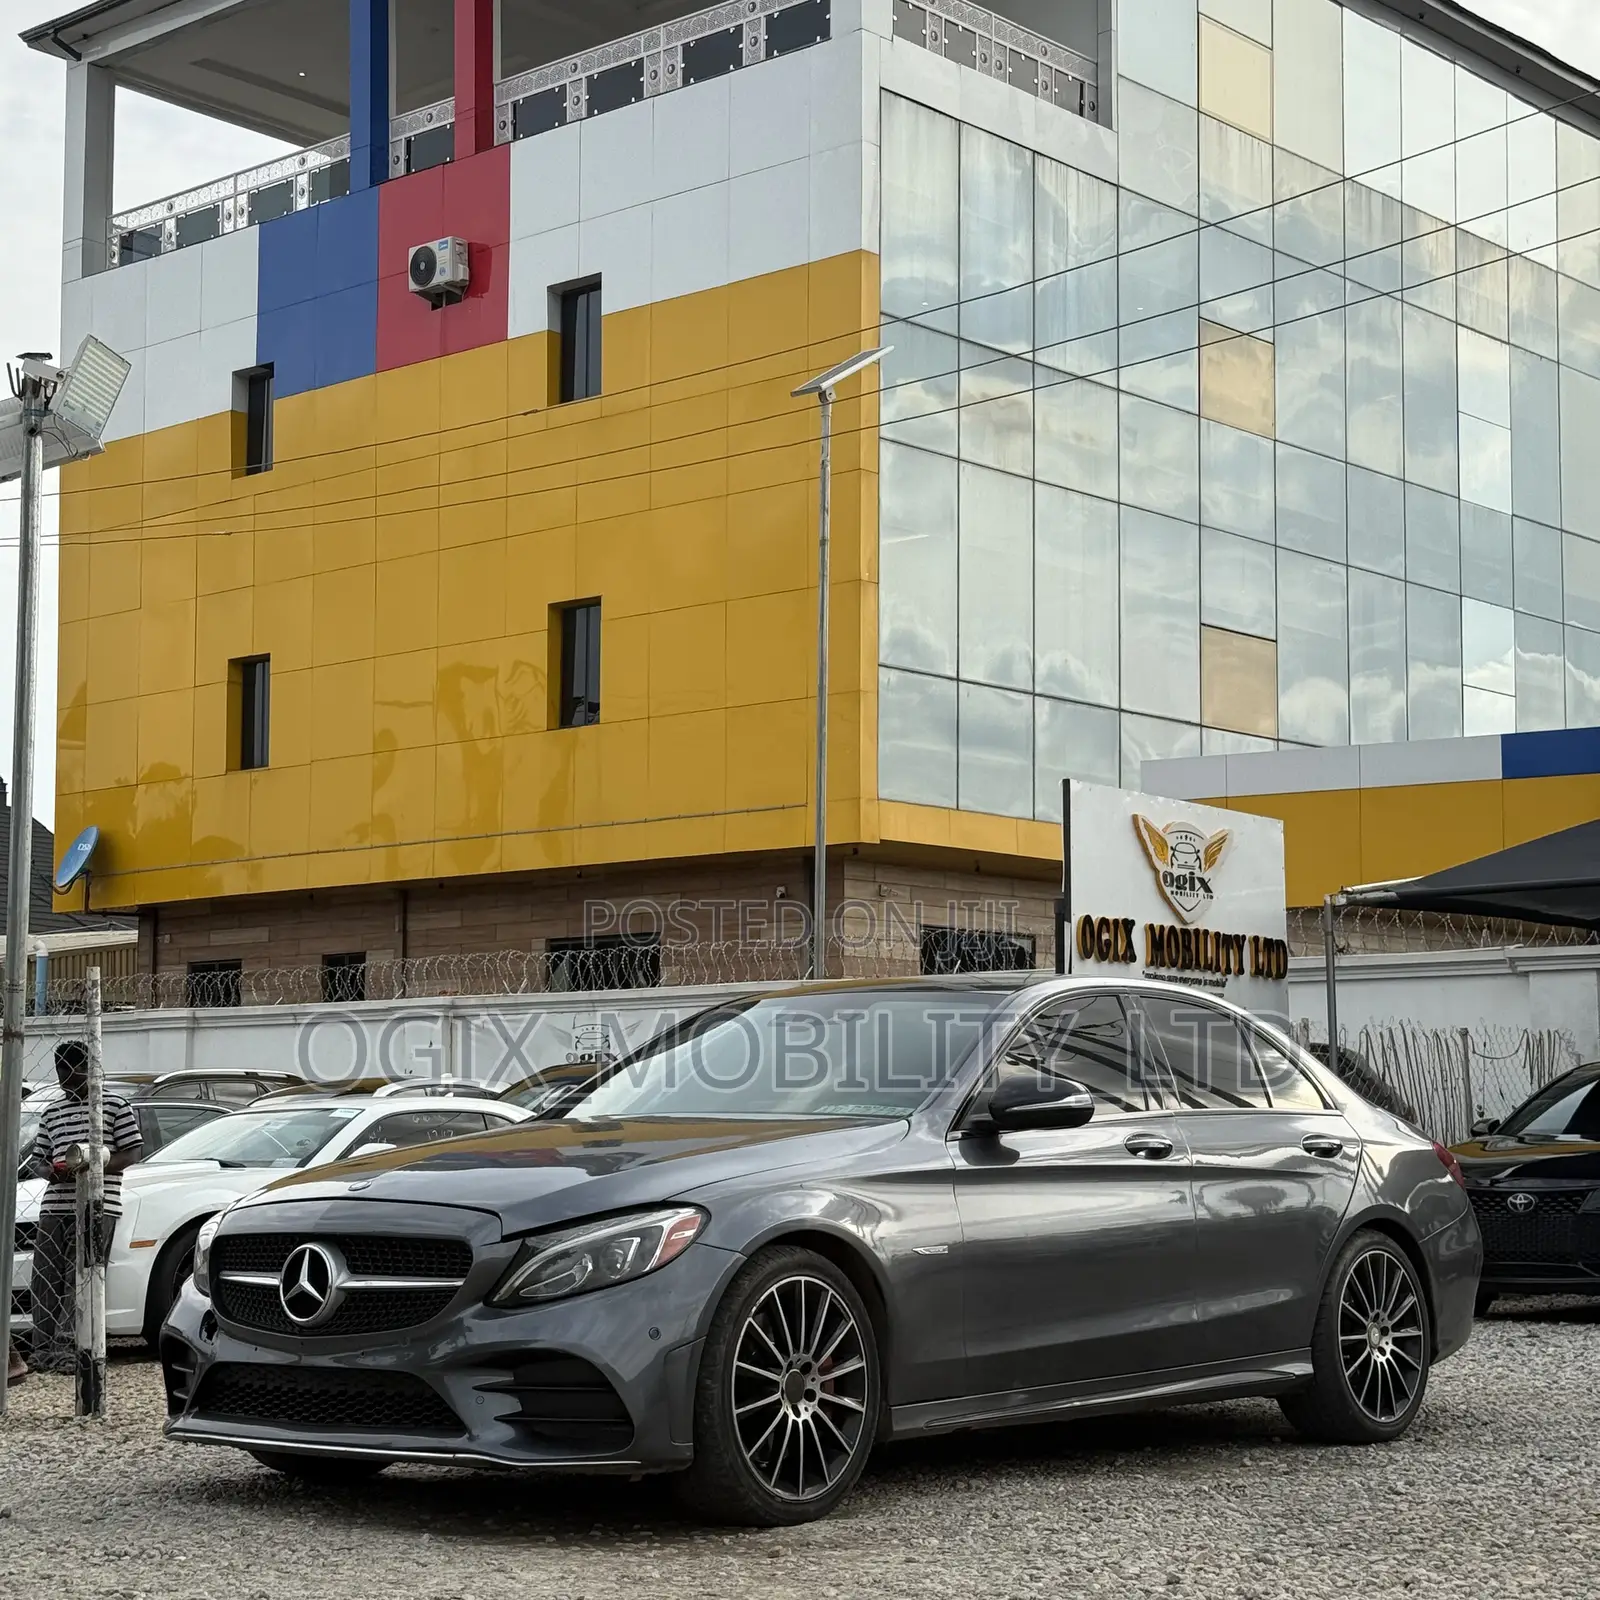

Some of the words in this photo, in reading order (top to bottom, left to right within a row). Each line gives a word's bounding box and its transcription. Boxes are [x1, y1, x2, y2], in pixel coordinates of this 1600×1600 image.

[1076, 914, 1136, 963] OGIX
[1144, 923, 1246, 976] MOBILITY
[1248, 935, 1288, 979] LTD
